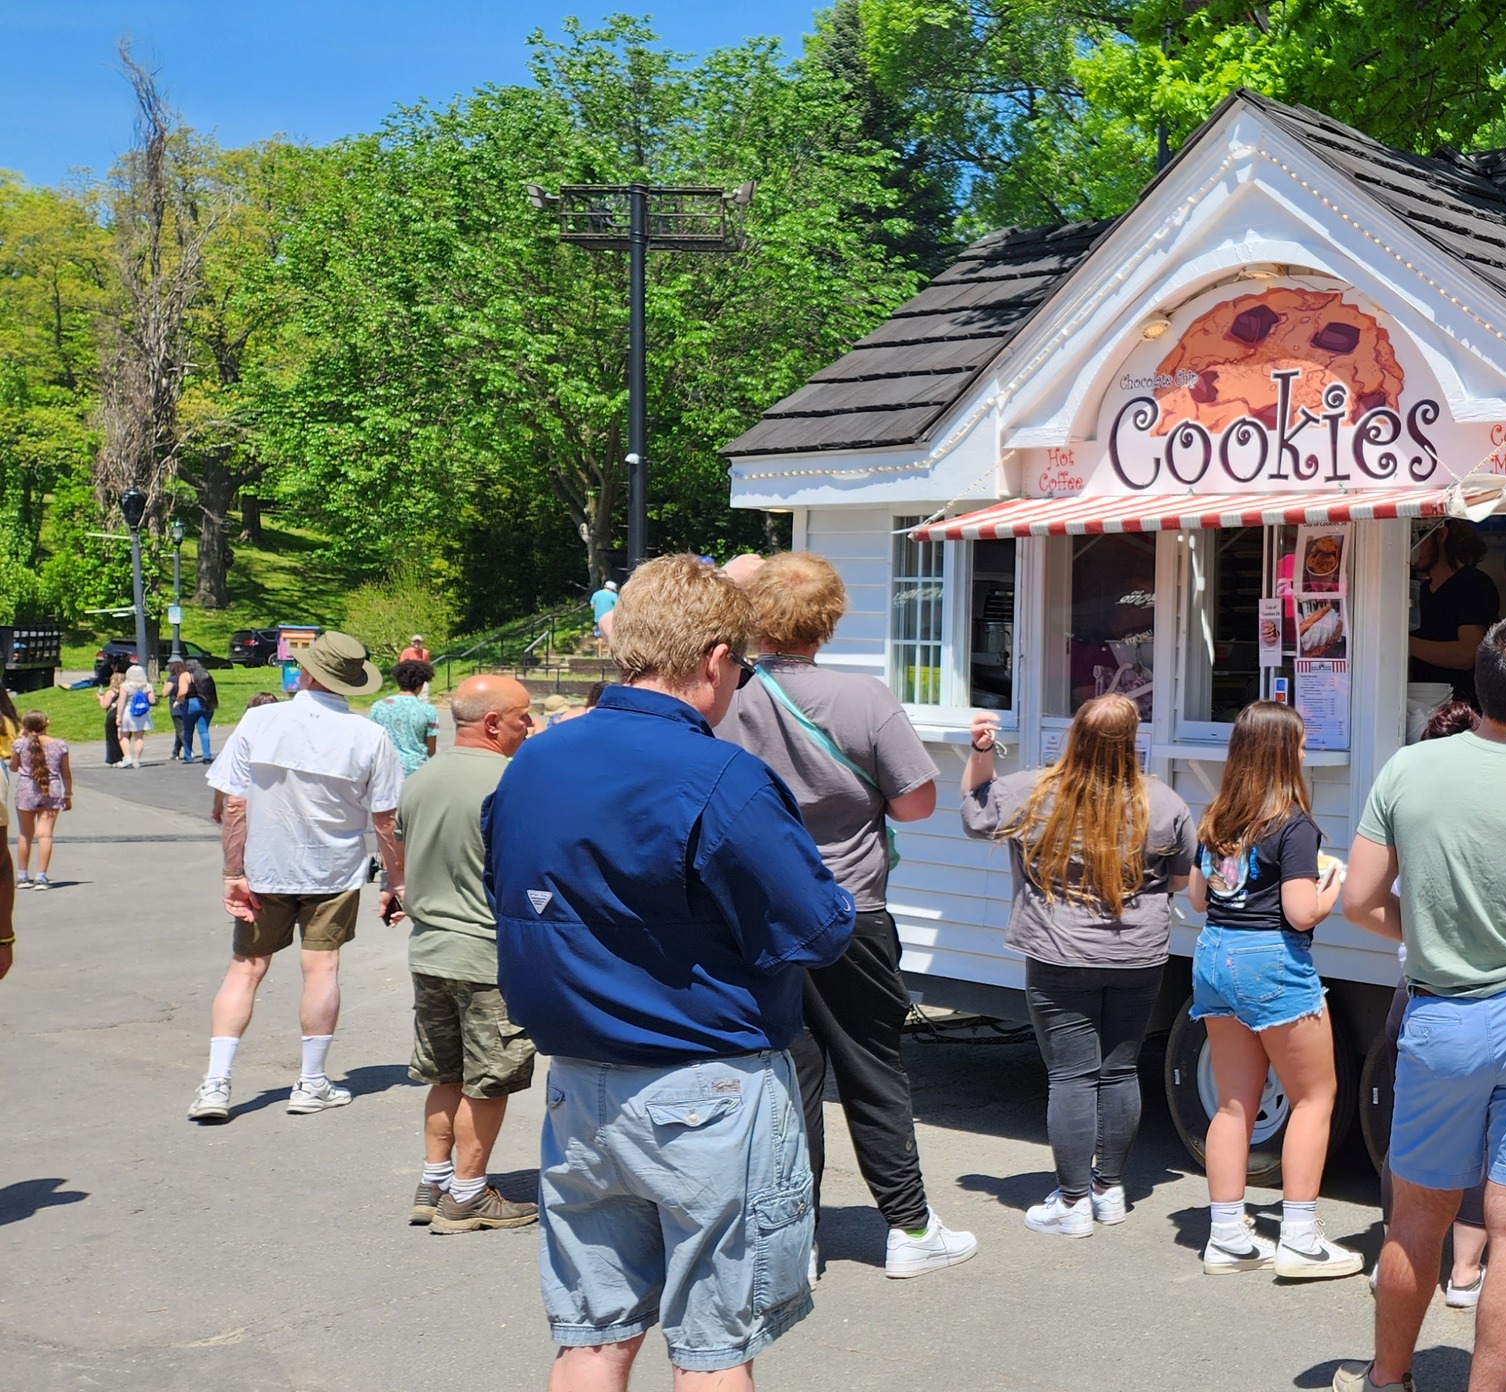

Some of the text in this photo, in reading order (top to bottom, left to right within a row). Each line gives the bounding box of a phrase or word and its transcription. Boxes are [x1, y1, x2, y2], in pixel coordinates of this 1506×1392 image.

[1119, 368, 1199, 390] Chocolate Chip
[1108, 370, 1440, 490] Cookies
[1047, 447, 1075, 471] Hot
[1039, 471, 1084, 492] Coffee
